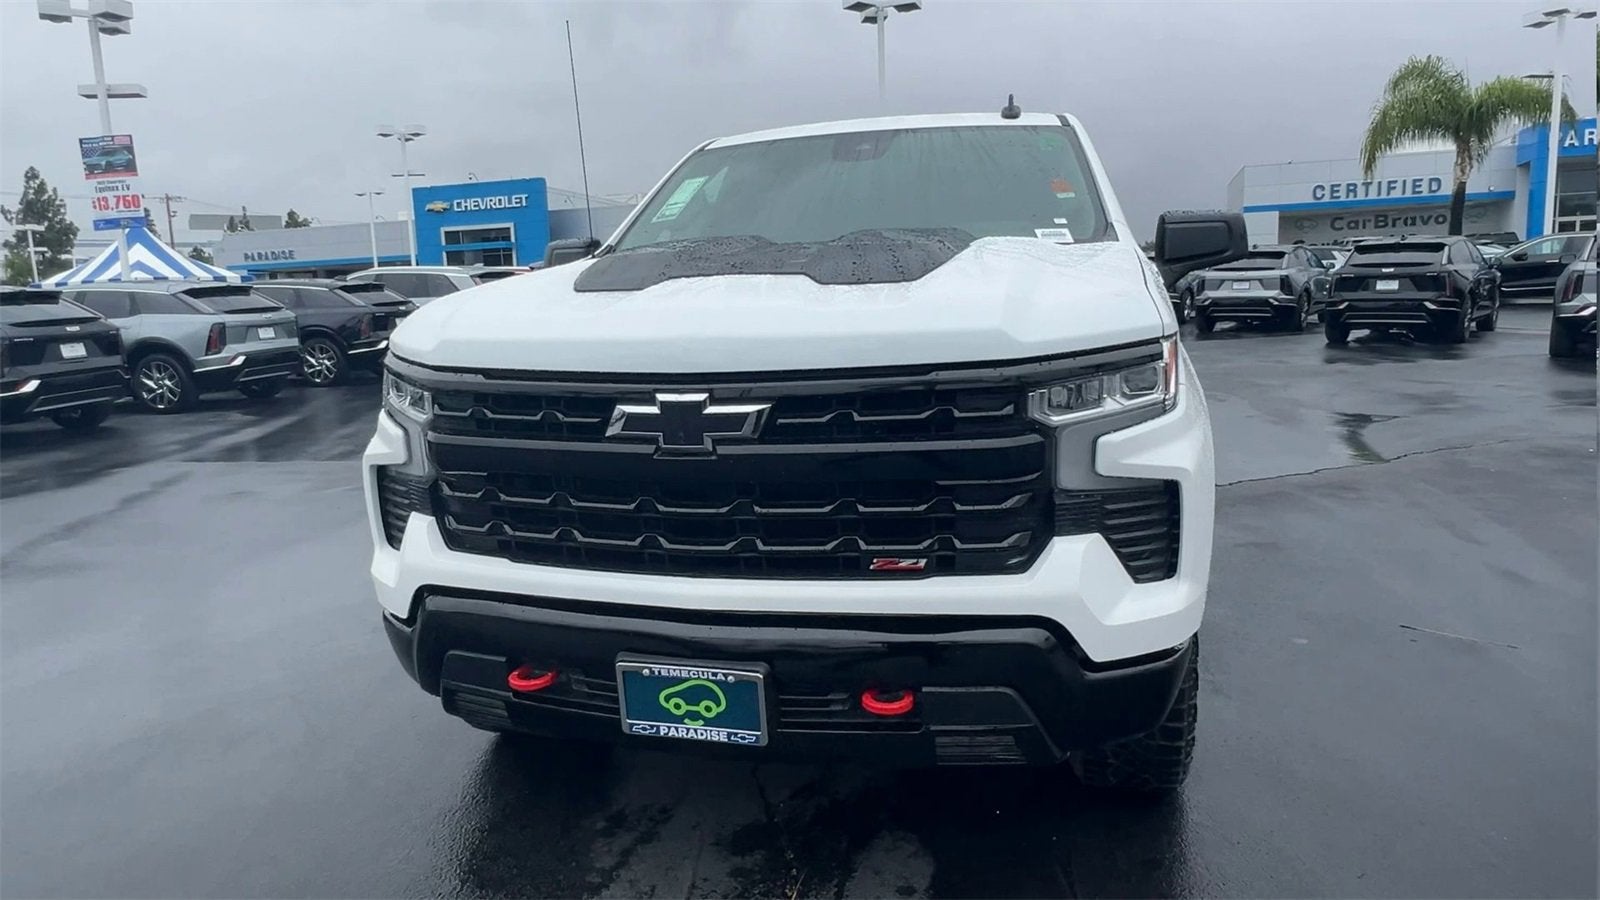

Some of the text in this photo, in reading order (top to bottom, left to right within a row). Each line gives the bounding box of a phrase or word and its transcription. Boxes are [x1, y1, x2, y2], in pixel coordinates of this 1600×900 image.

[1560, 128, 1597, 147] AR
[1312, 177, 1443, 200] CERTIFIED
[453, 194, 528, 212] CHEVROLET
[1330, 213, 1448, 231] CarBravo
[243, 250, 296, 262] PARADISE
[869, 558, 928, 571] Z71
[652, 667, 726, 681] TEMECULA
[659, 726, 728, 742] PARADISE
